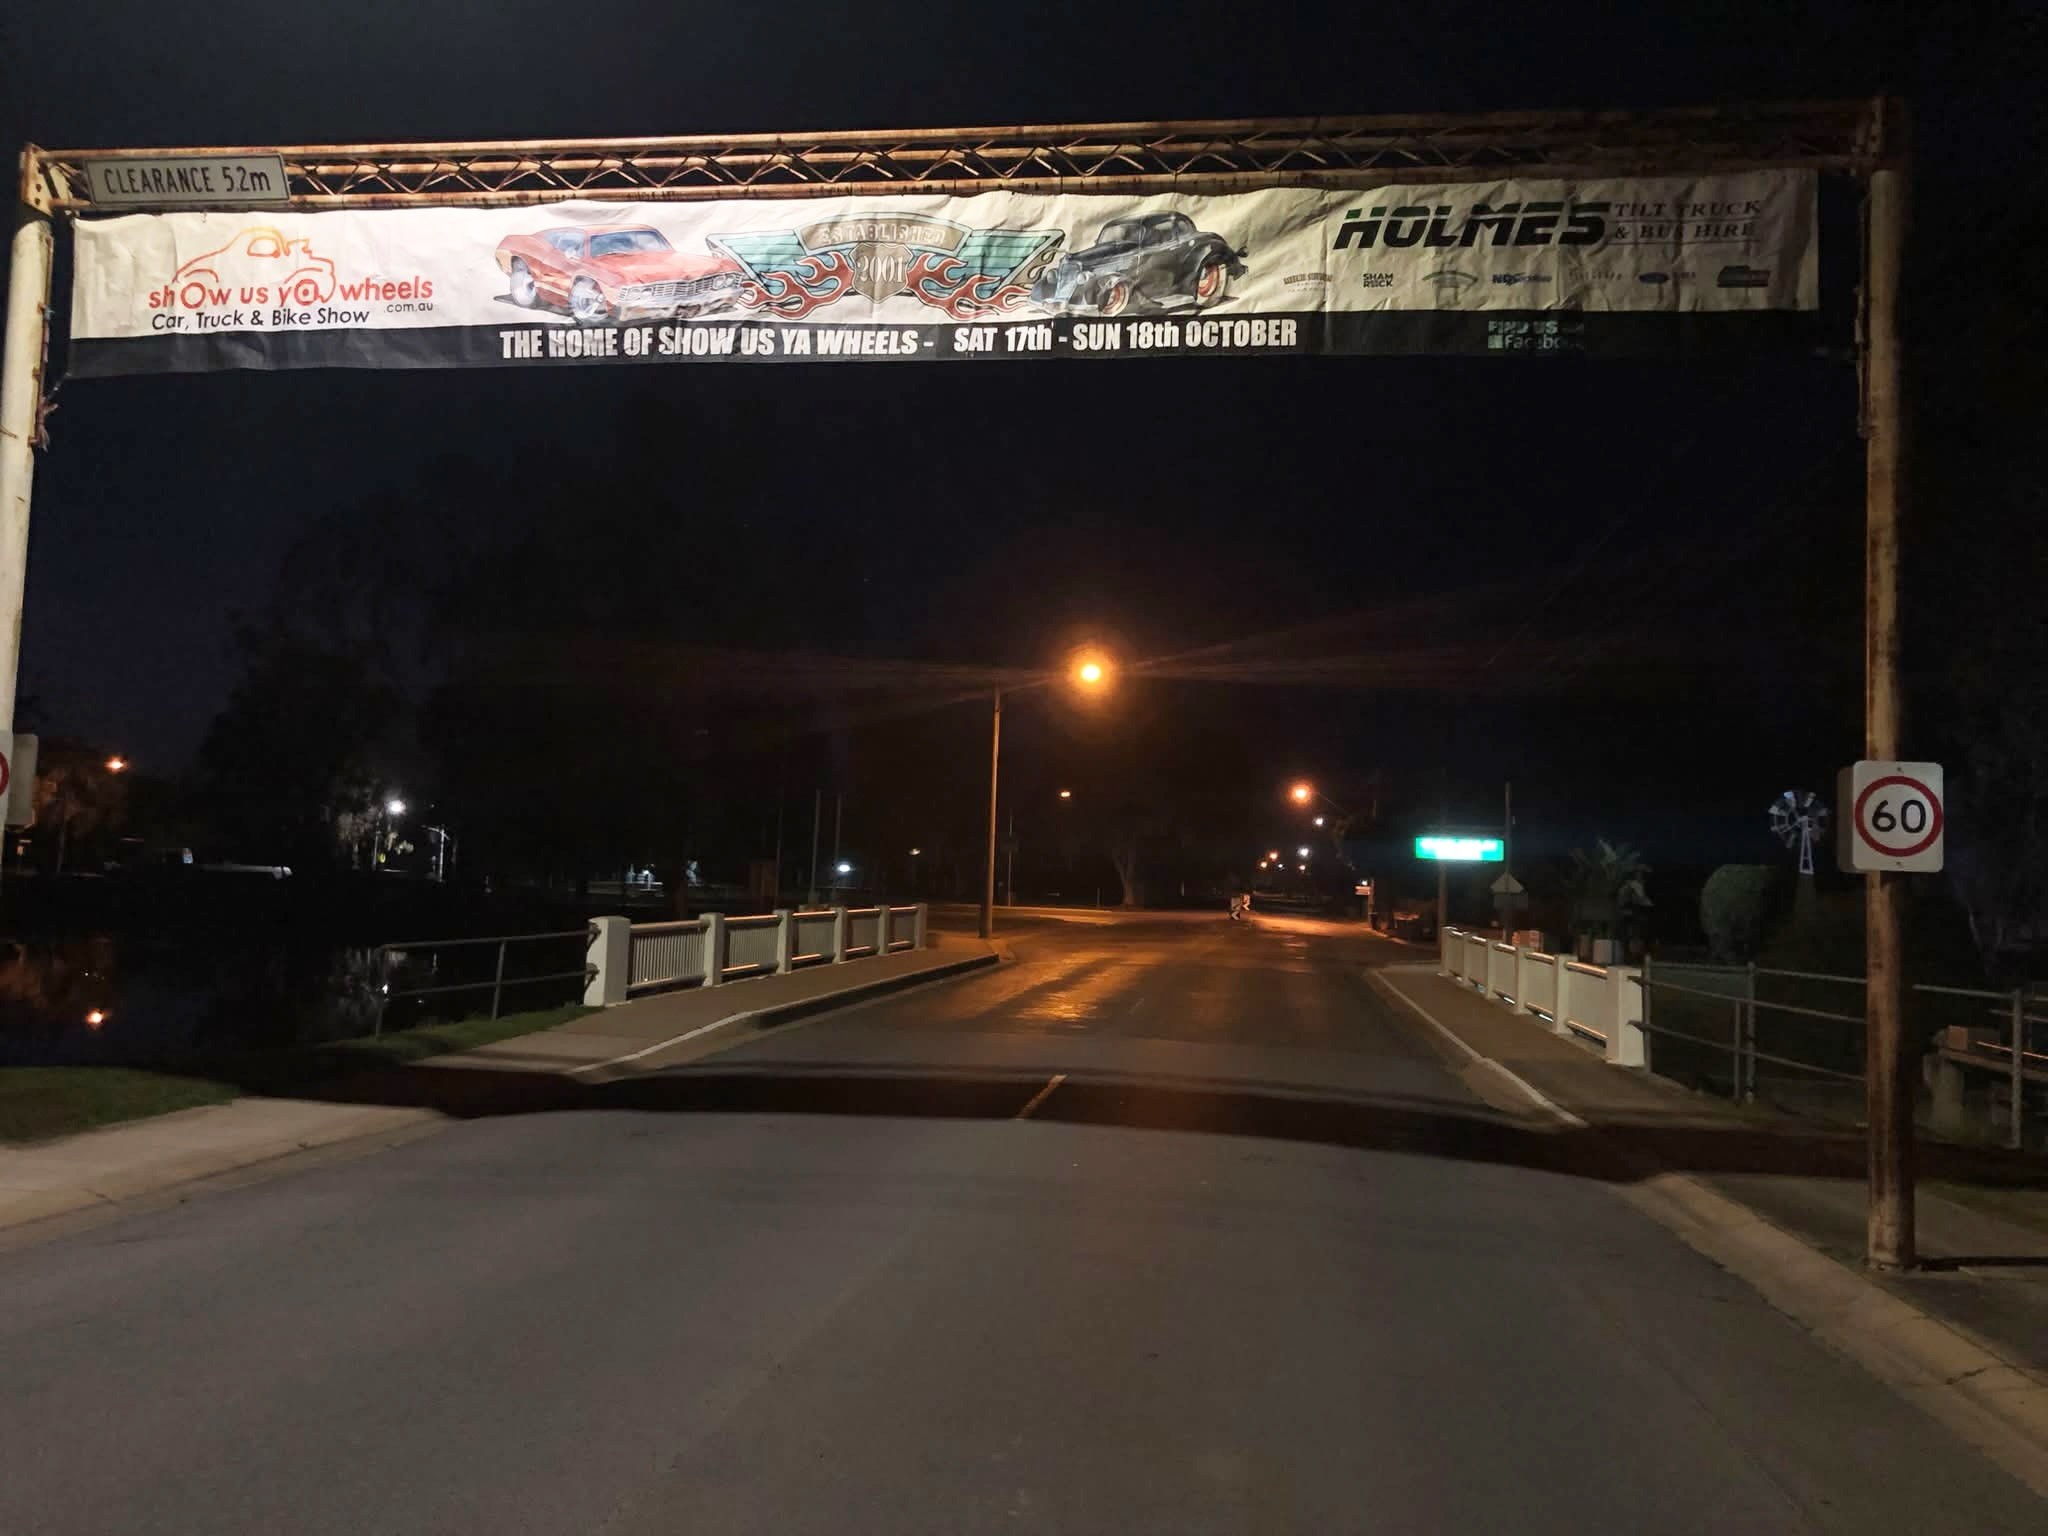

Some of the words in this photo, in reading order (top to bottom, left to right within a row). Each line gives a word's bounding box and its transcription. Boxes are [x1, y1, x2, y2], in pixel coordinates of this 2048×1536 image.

[104, 166, 216, 195] CLEARANCE
[1615, 203, 1668, 218] TILT
[1678, 200, 1761, 217] TRUCK
[819, 223, 946, 244] ESTABLISHED
[1333, 201, 1611, 249] HOLMES
[1614, 224, 1628, 239] &
[1694, 221, 1756, 238] HIRE
[856, 255, 905, 283] 2001
[1363, 272, 1394, 281] SHAM
[239, 285, 268, 305] us
[340, 276, 433, 302] wheels
[152, 314, 189, 332] Car,
[196, 309, 244, 328] Truck
[250, 308, 264, 326] &
[272, 307, 311, 326] Bike
[317, 306, 370, 325] Show
[500, 330, 542, 359] THE
[549, 329, 618, 358] HOME
[623, 328, 655, 356] OF
[660, 327, 737, 355] SHOW
[741, 328, 774, 355] US
[780, 328, 811, 354] YA
[817, 327, 918, 354] WHEELS
[953, 326, 997, 353] SAT
[1005, 322, 1052, 351] 17th
[1073, 322, 1120, 350] SUN
[1126, 320, 1179, 349] 18th
[1186, 319, 1297, 347] OCTOBER
[1871, 799, 1926, 834] 60
